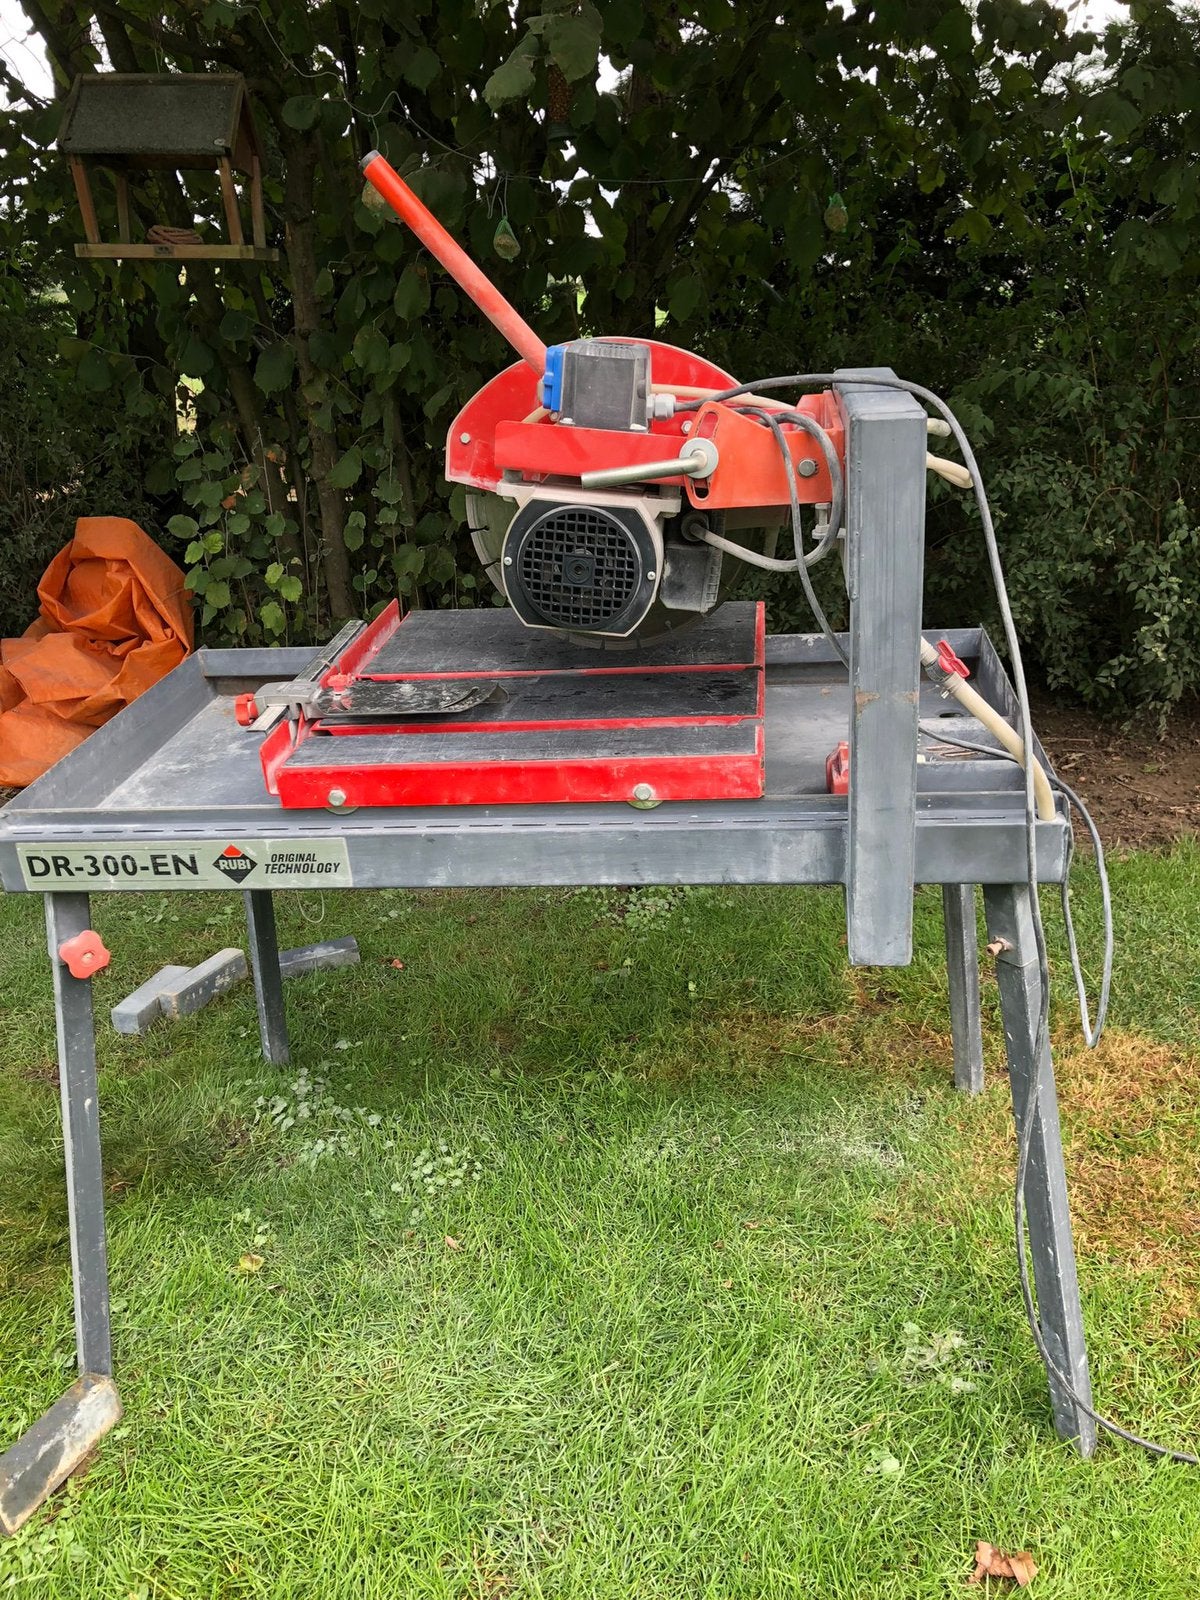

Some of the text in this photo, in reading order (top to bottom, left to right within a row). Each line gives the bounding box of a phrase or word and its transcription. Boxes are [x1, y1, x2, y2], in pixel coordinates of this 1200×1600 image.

[270, 853, 317, 863] ORIGINAL
[26, 854, 200, 877] DR-300-EN
[217, 859, 250, 871] RUBI
[264, 862, 340, 875] TECHNOLOGY
